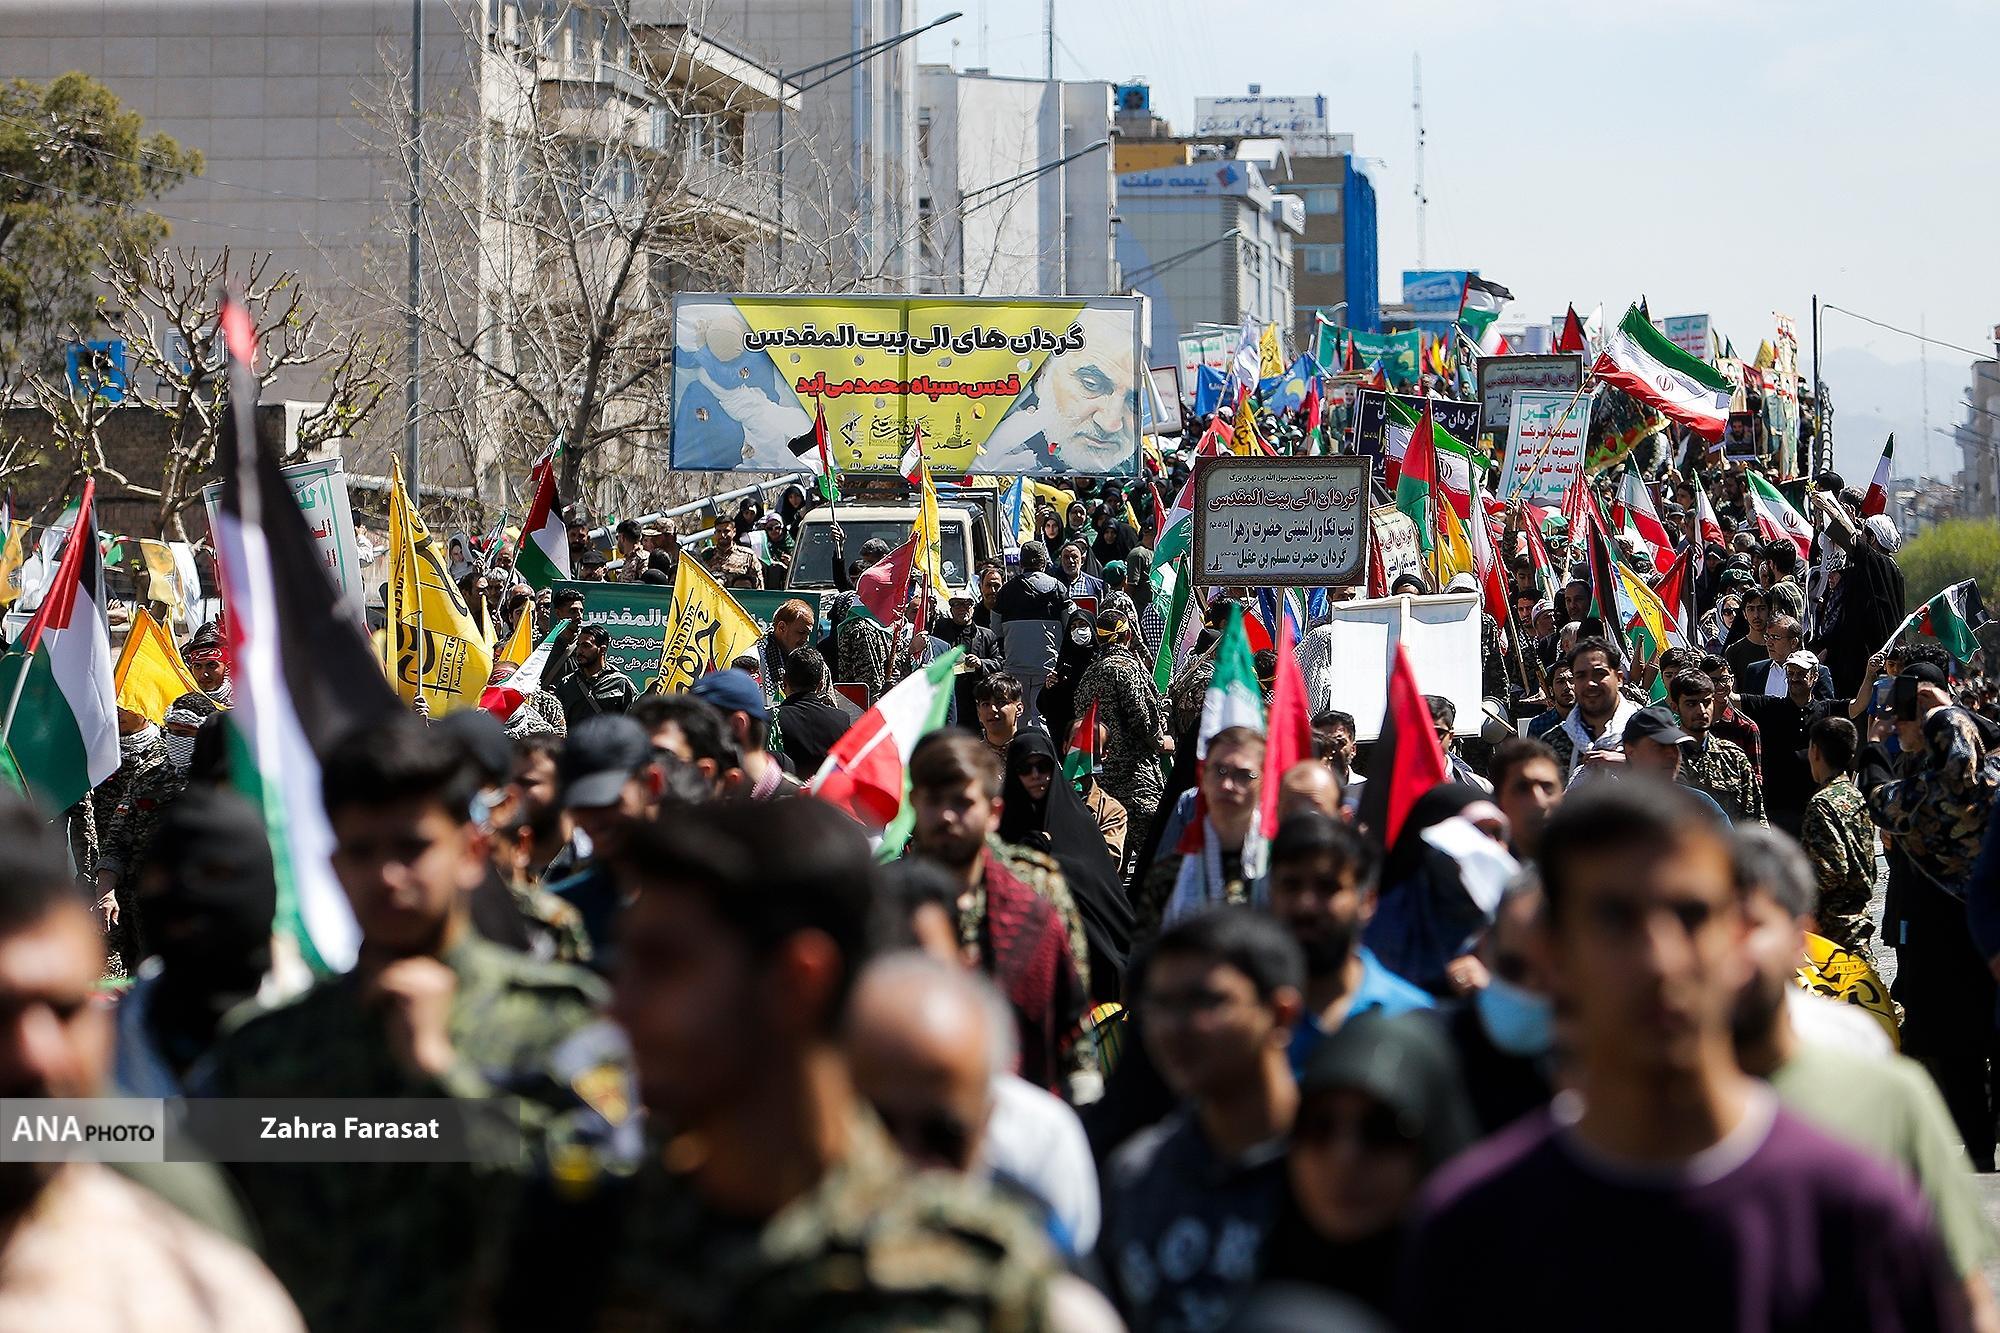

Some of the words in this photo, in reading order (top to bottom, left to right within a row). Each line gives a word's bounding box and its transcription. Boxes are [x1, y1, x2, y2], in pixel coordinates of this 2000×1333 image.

[1121, 171, 1163, 187] ملت
[1168, 177, 1209, 193] بیمه
[743, 323, 856, 352] المقدس
[856, 332, 909, 355] بیت
[910, 324, 952, 355] الی
[951, 325, 1008, 354] های
[1008, 321, 1086, 355] گردان
[824, 379, 856, 398] می
[854, 377, 910, 395] محمد
[911, 376, 960, 402] سپاه
[1448, 410, 1477, 431] گردان
[1208, 488, 1264, 511] المقدس
[1263, 491, 1291, 510] بیت
[1290, 487, 1317, 511] الی
[1316, 487, 1360, 511] گردان
[1229, 517, 1251, 544] زهرا
[1252, 518, 1283, 544] حضرت
[1337, 517, 1355, 544] تیپ
[1237, 547, 1257, 569] عقیل
[1257, 552, 1269, 570] بن
[1269, 546, 1291, 569] مسلم
[1291, 547, 1319, 569] حضرت
[1320, 546, 1347, 569] گردان
[578, 606, 661, 627] المقدس
[610, 636, 646, 649] مجتبی
[645, 638, 664, 651] سن
[438, 652, 453, 684] You're
